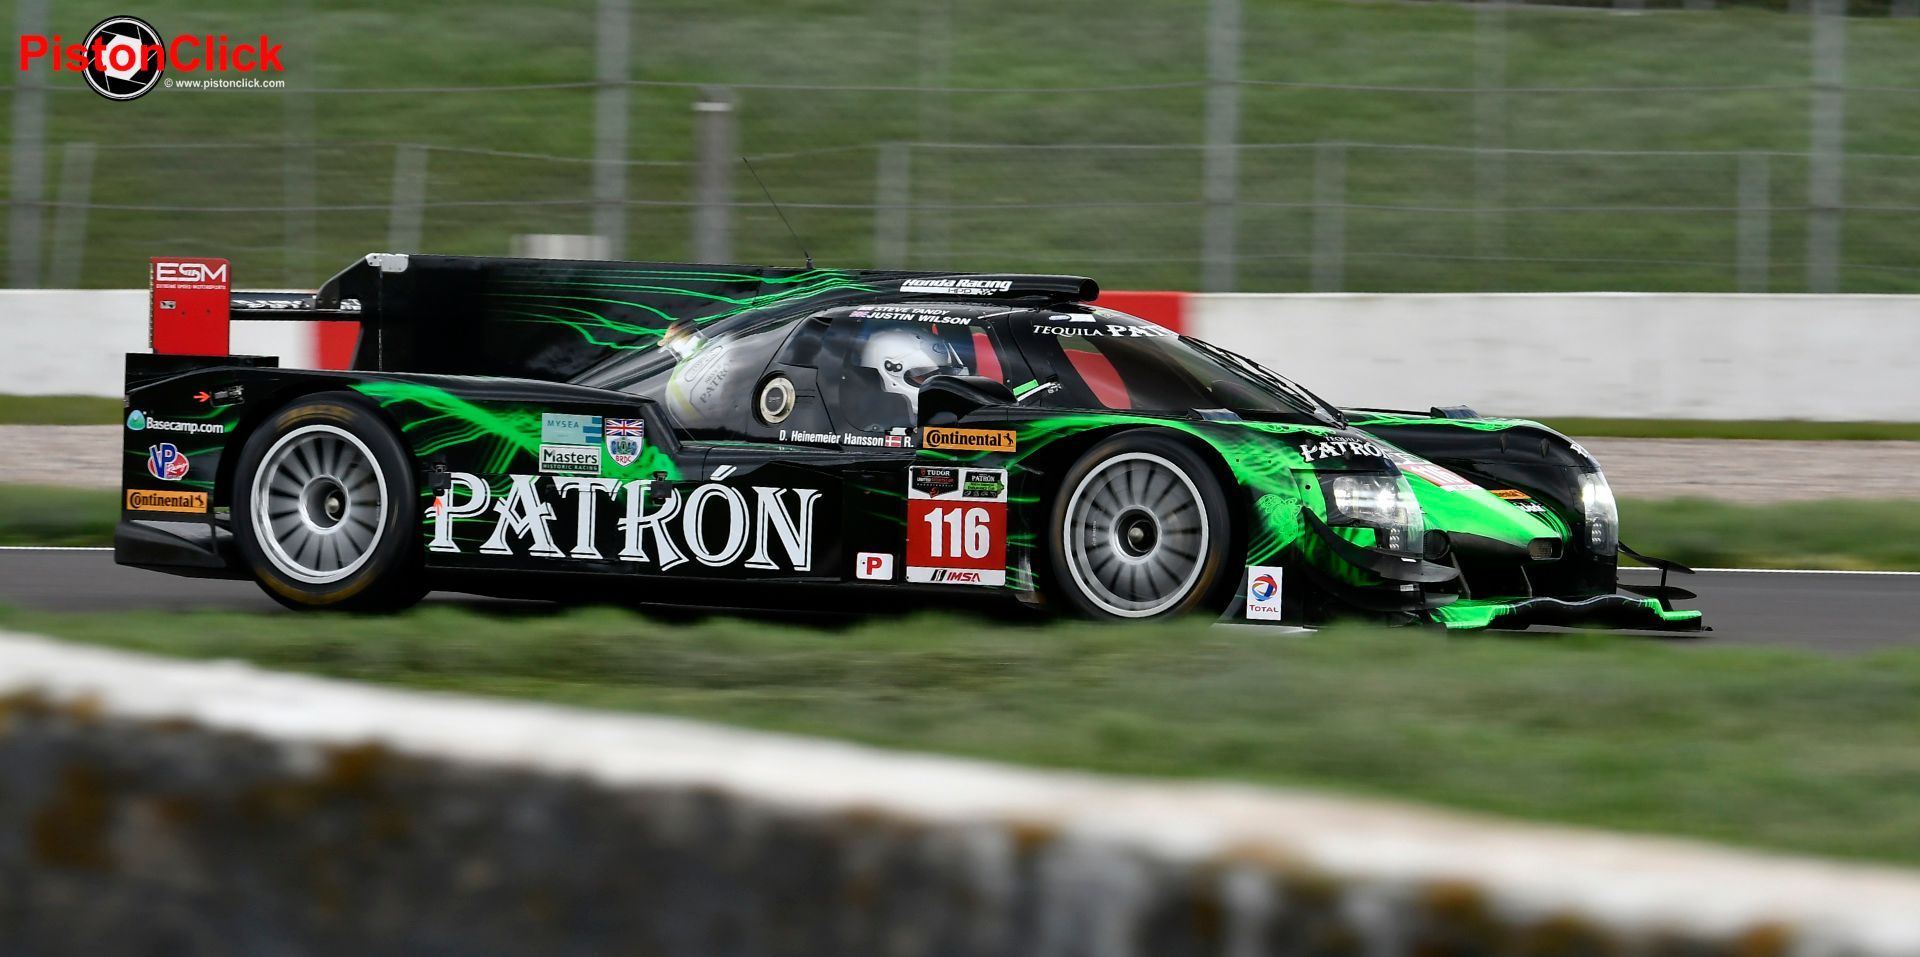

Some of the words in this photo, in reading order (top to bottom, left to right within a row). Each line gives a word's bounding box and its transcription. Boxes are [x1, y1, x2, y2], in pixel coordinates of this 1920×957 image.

[156, 262, 227, 283] ESM
[902, 279, 956, 287] Honda
[956, 279, 1013, 292] Racing
[867, 311, 912, 321] JUSTIN
[918, 314, 972, 325] WILSON
[911, 308, 950, 316] TANDY
[1032, 325, 1103, 338] TEQUILA
[146, 416, 224, 435] Basecamp.com
[547, 420, 580, 429] MYSEA
[779, 429, 788, 441] D.
[791, 430, 841, 444] Heinemeier
[843, 433, 884, 447] Hansson
[926, 430, 1002, 447] Continental
[149, 442, 178, 479] VP
[543, 448, 598, 464] Masters
[615, 455, 632, 463] BRDC
[130, 491, 194, 509] Continental
[424, 465, 823, 572] PATRÓN
[924, 507, 991, 559] 116
[866, 556, 883, 576] P
[946, 571, 981, 583] IMSA
